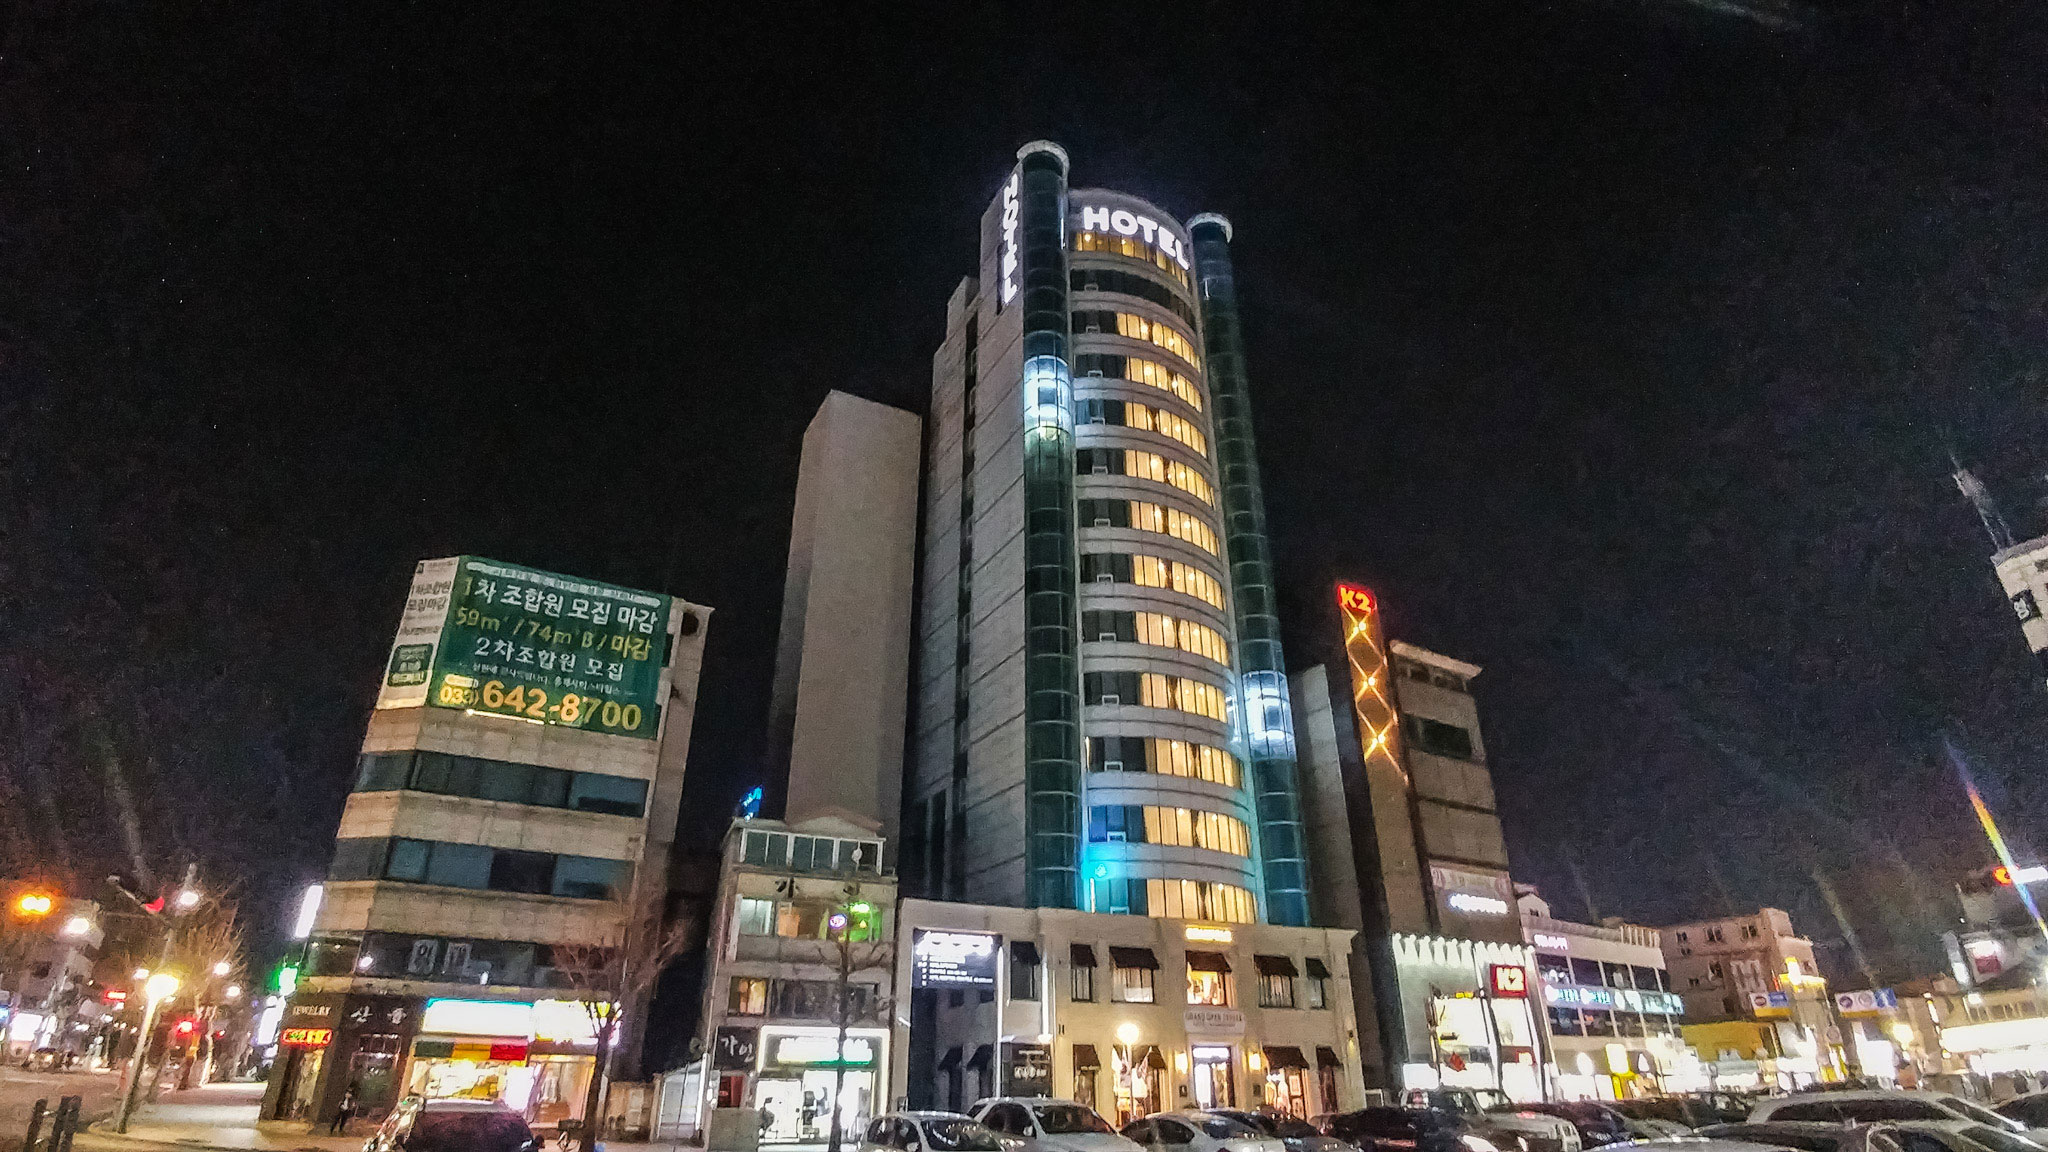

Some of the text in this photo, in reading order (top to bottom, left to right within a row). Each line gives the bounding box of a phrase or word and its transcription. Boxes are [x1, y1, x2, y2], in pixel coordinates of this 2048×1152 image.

[1002, 173, 1018, 304] HOTEL
[1083, 206, 1190, 271] HOTEL
[500, 584, 564, 618] 조합원
[567, 599, 611, 625] 모집
[617, 607, 658, 634] 마감
[1340, 587, 1372, 615] K2
[610, 635, 652, 660] 마감
[585, 658, 624, 681] 모집
[483, 680, 642, 731] 642-8700
[1496, 967, 1525, 992] K2
[292, 1005, 332, 1017] JEWELRY
